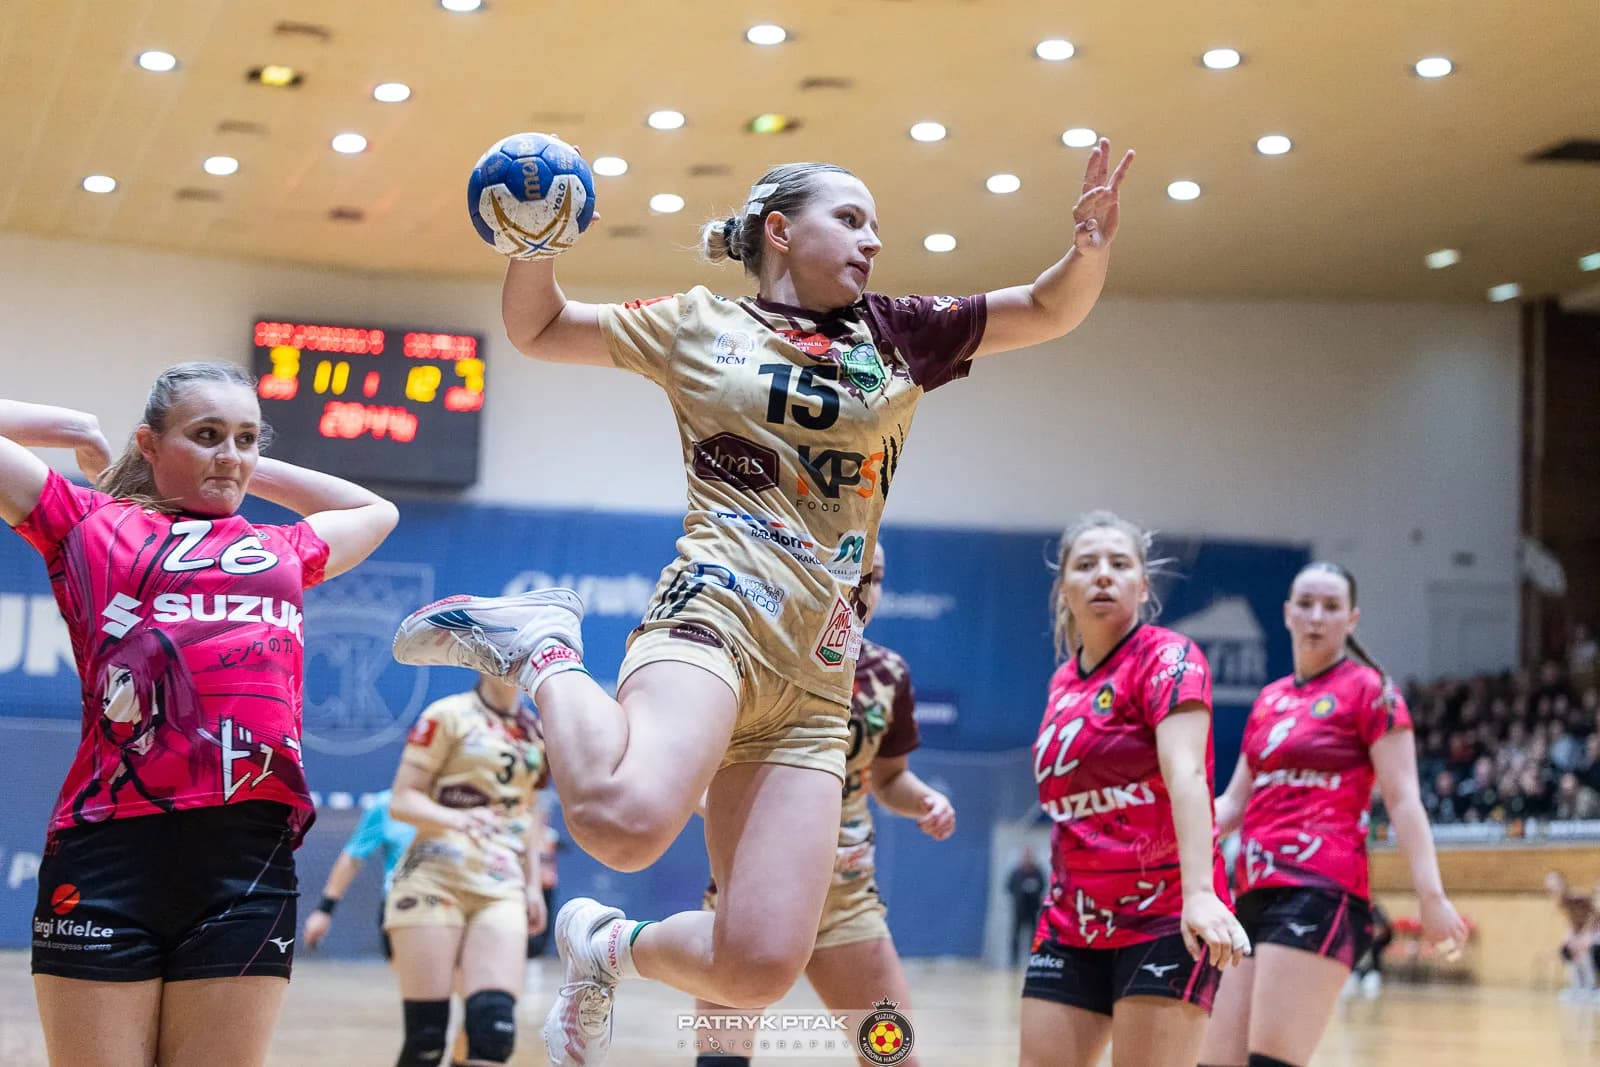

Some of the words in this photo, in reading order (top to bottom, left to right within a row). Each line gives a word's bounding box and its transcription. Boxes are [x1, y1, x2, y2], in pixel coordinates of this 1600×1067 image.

[552, 183, 566, 212] YOLO
[716, 355, 746, 365] DCM
[758, 362, 840, 430] 15
[796, 500, 841, 513] FOOD
[162, 520, 279, 575] 26
[153, 592, 304, 646] SUZUK
[1034, 715, 1084, 783] 22
[497, 752, 515, 785] 3
[1040, 782, 1156, 822] UZUKI
[56, 919, 114, 938] Kielce
